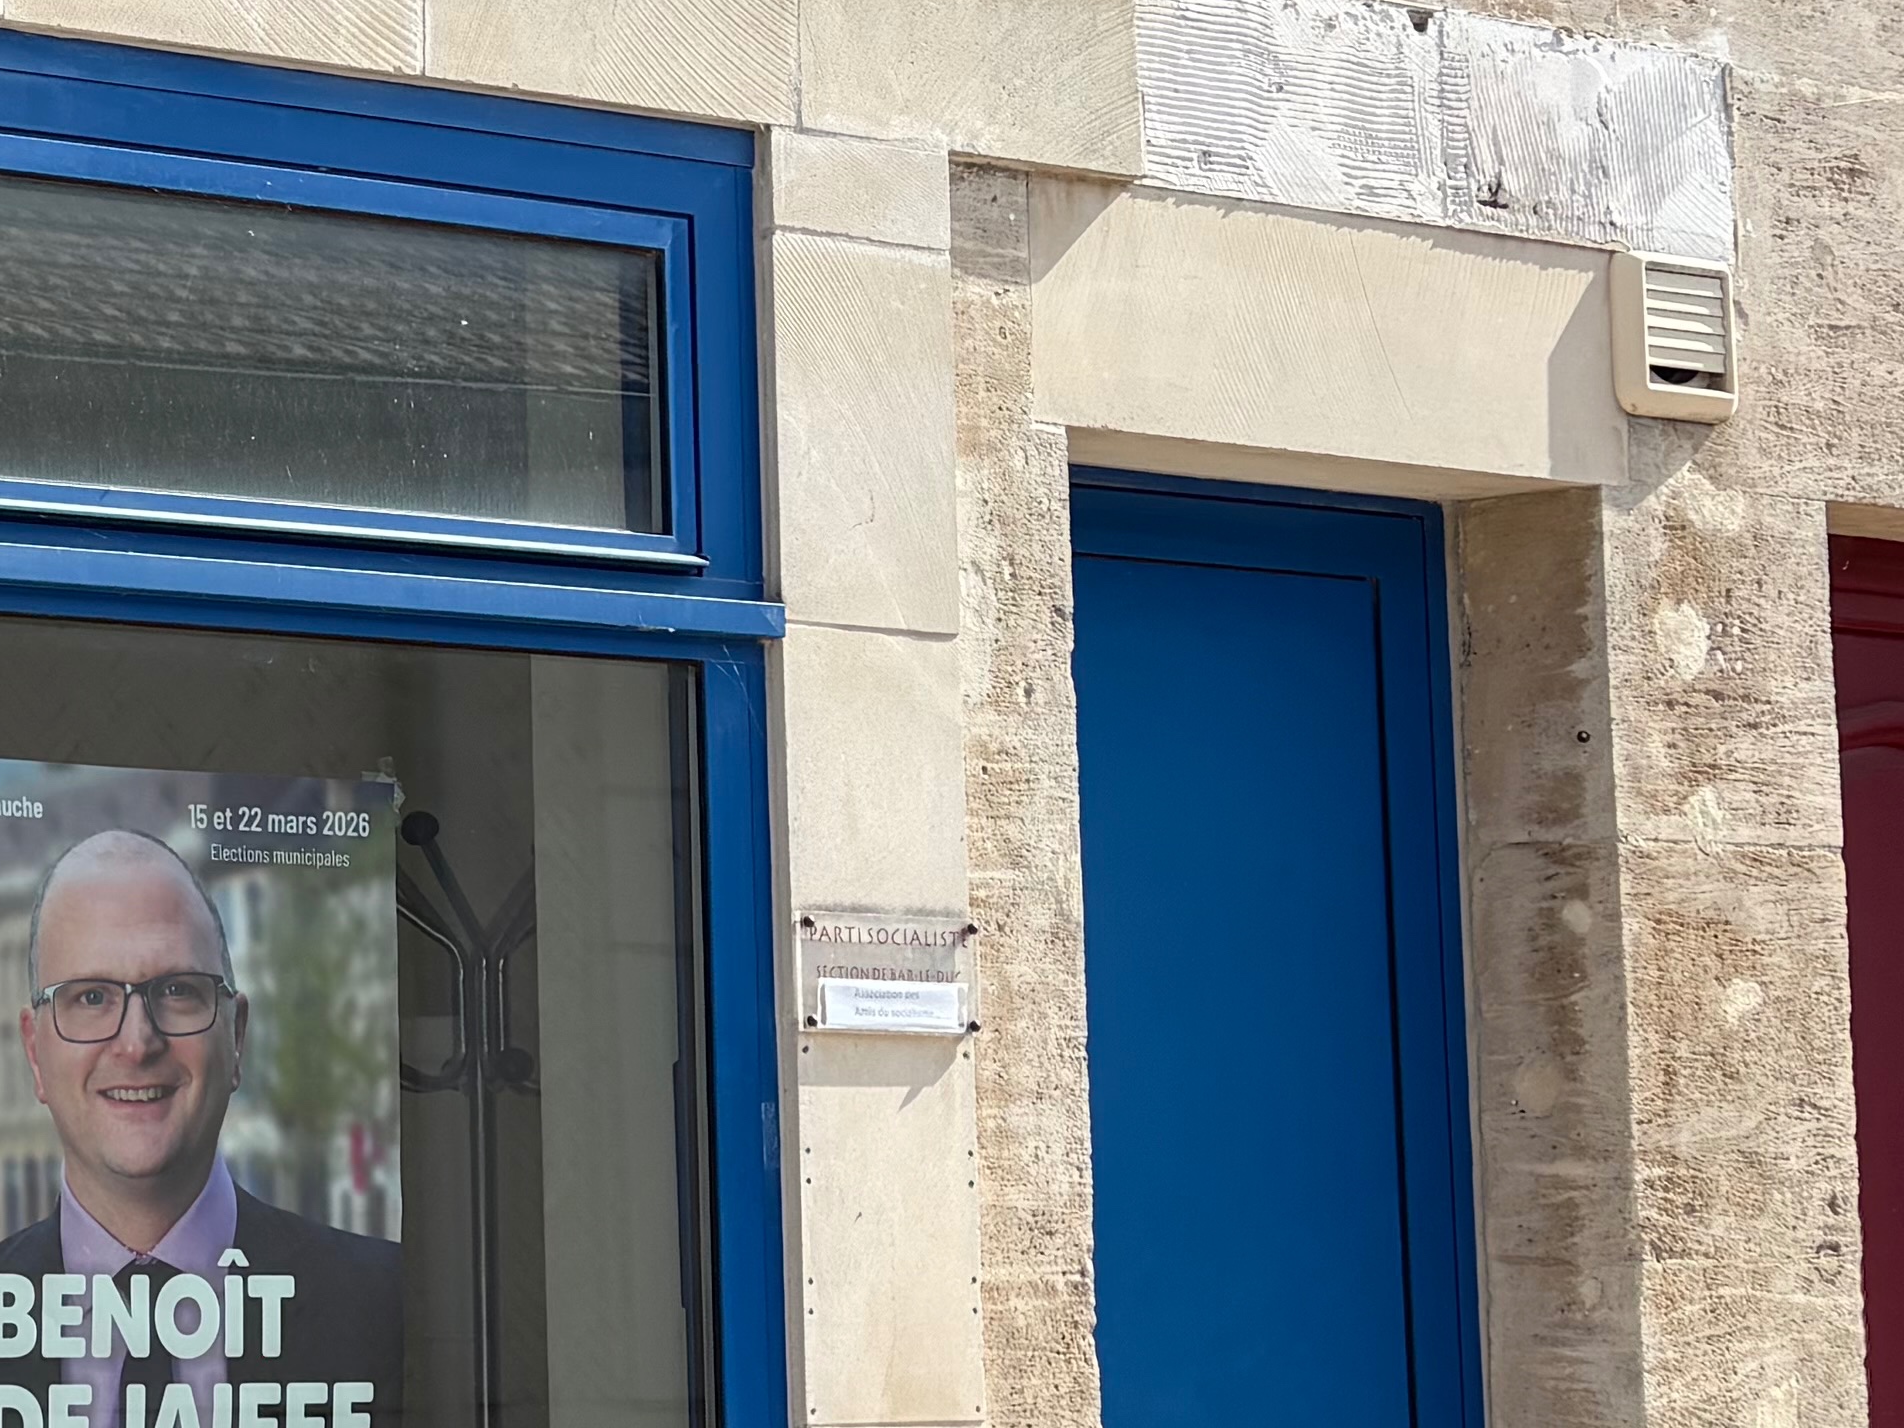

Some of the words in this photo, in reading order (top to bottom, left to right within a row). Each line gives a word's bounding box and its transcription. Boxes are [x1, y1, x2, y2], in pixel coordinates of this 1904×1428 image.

[188, 804, 208, 829] 15
[213, 807, 233, 831] et
[238, 806, 263, 832] 22
[267, 813, 317, 835] mars
[322, 811, 370, 838] 2026
[210, 843, 270, 864] Elections
[273, 847, 350, 869] municipales
[808, 925, 863, 945] PARTI
[816, 965, 870, 980] SECTION
[872, 967, 886, 981] DE
